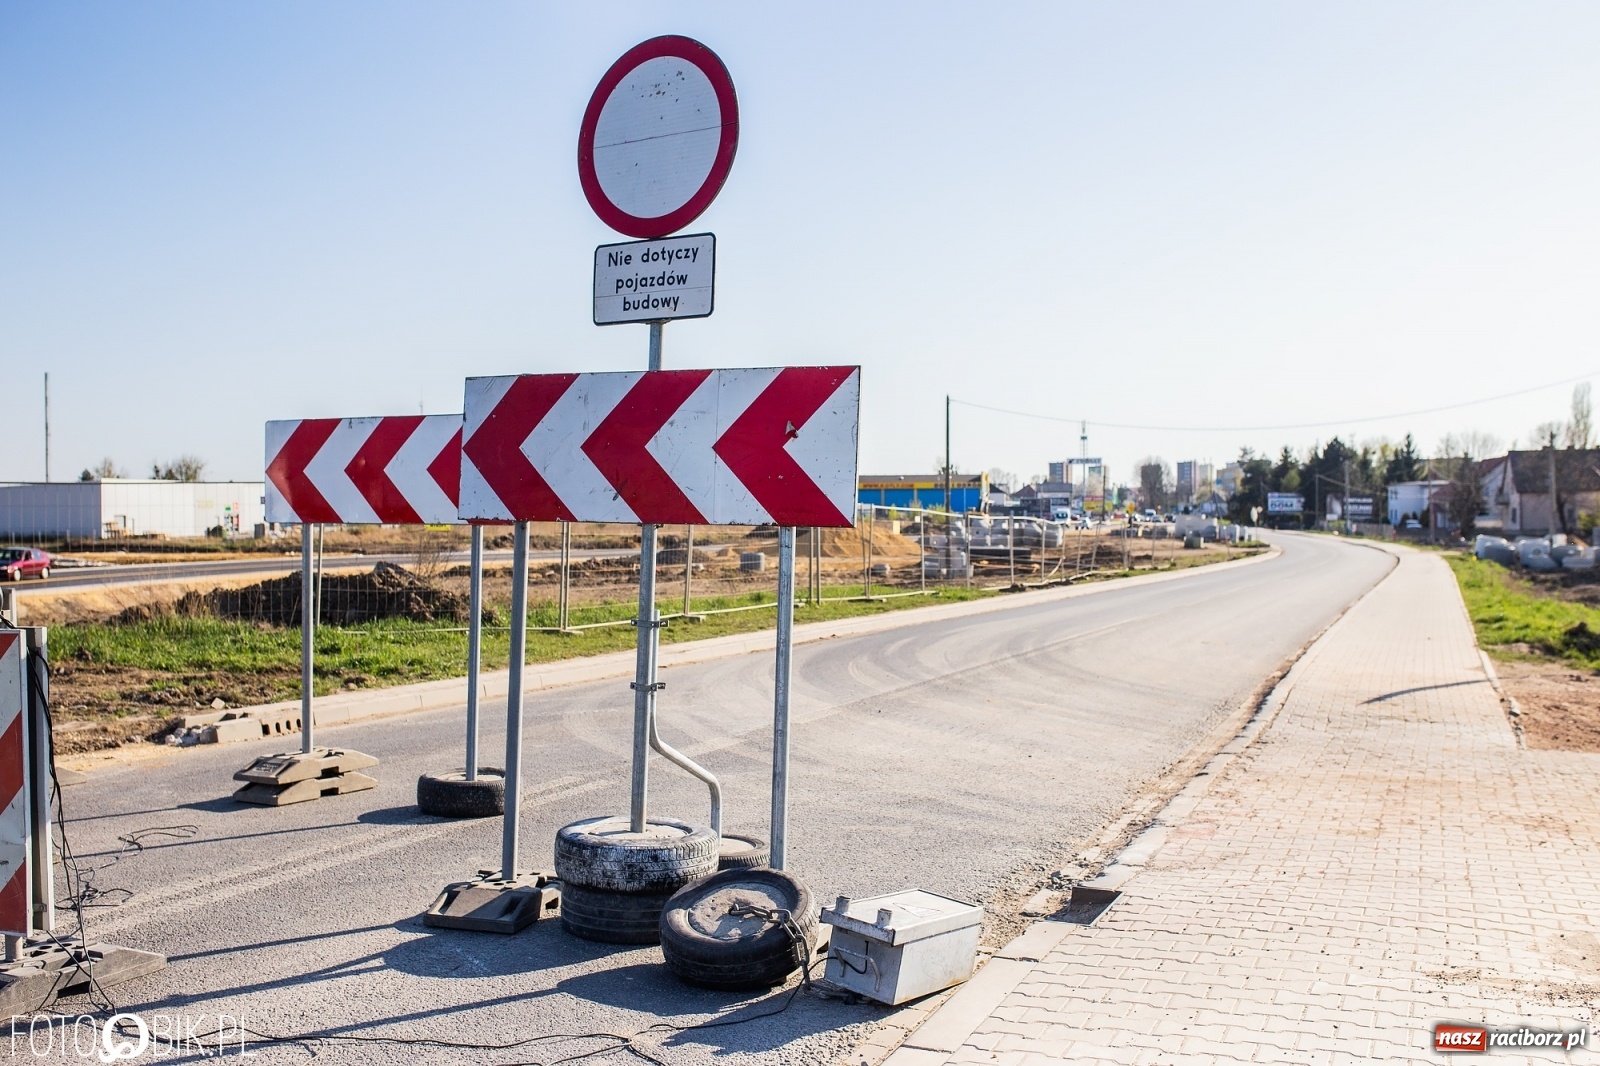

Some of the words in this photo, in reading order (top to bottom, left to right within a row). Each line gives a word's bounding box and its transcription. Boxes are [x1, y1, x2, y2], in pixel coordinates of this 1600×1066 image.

[608, 251, 632, 267] Nie
[641, 246, 699, 265] dotyczy
[615, 270, 688, 294] pojazdów
[623, 294, 680, 311] budowy
